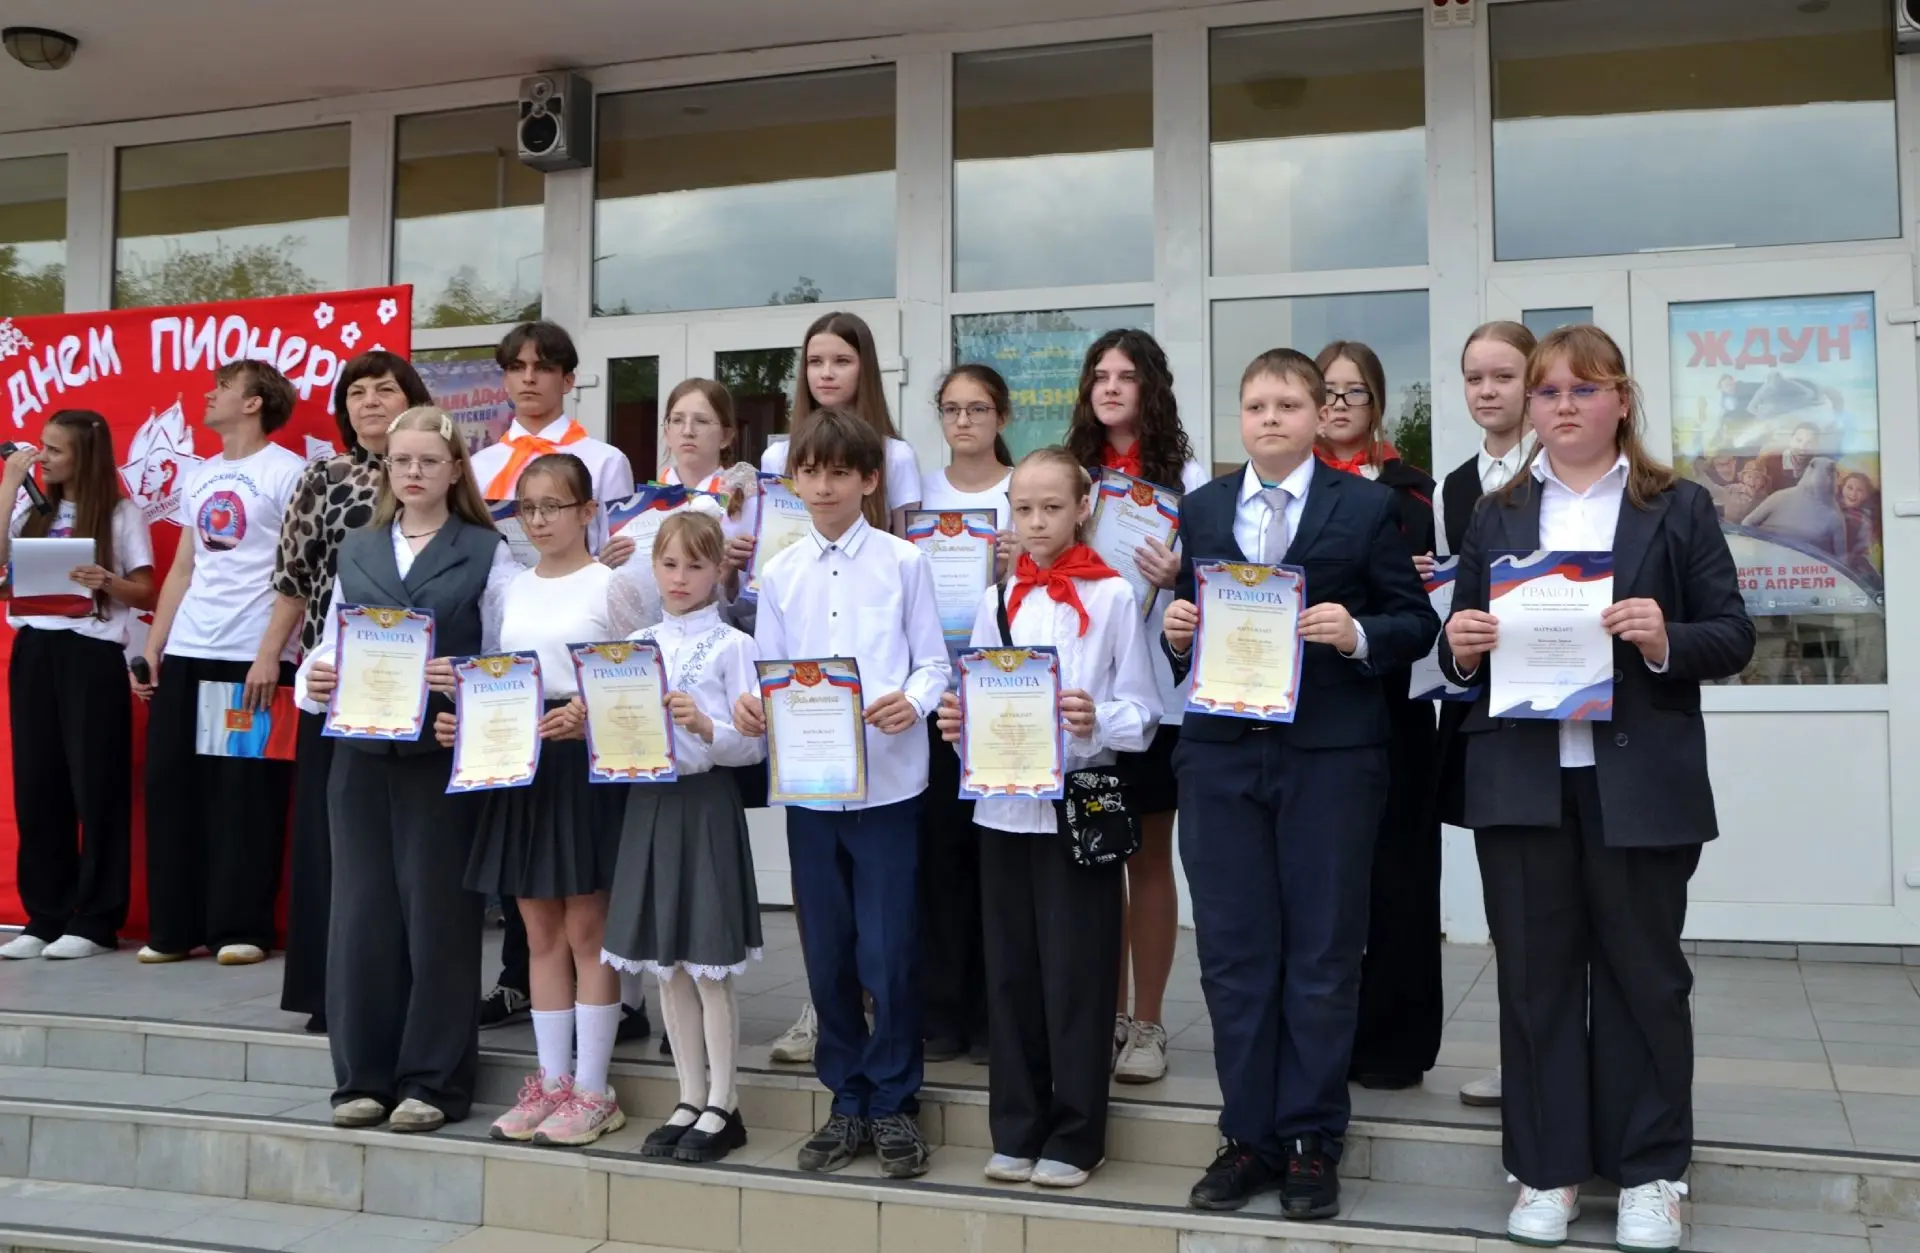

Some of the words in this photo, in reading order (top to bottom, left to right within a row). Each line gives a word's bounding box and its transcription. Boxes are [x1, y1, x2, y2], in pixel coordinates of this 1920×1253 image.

[1686, 325, 1852, 369] ЖДУН
[1737, 566, 1773, 577] ДИТЕ
[1792, 565, 1828, 575] КИНО
[1765, 577, 1836, 590] АПРЕЛЯ
[1218, 588, 1282, 604] ГРАМОТА
[1521, 586, 1585, 599] ГРАМОТА
[356, 629, 415, 643] ГРАМОТА
[593, 666, 648, 679] ГРАМОТА
[473, 680, 525, 694] ГРАМОТА
[979, 676, 1040, 688] ГРАМОТА
